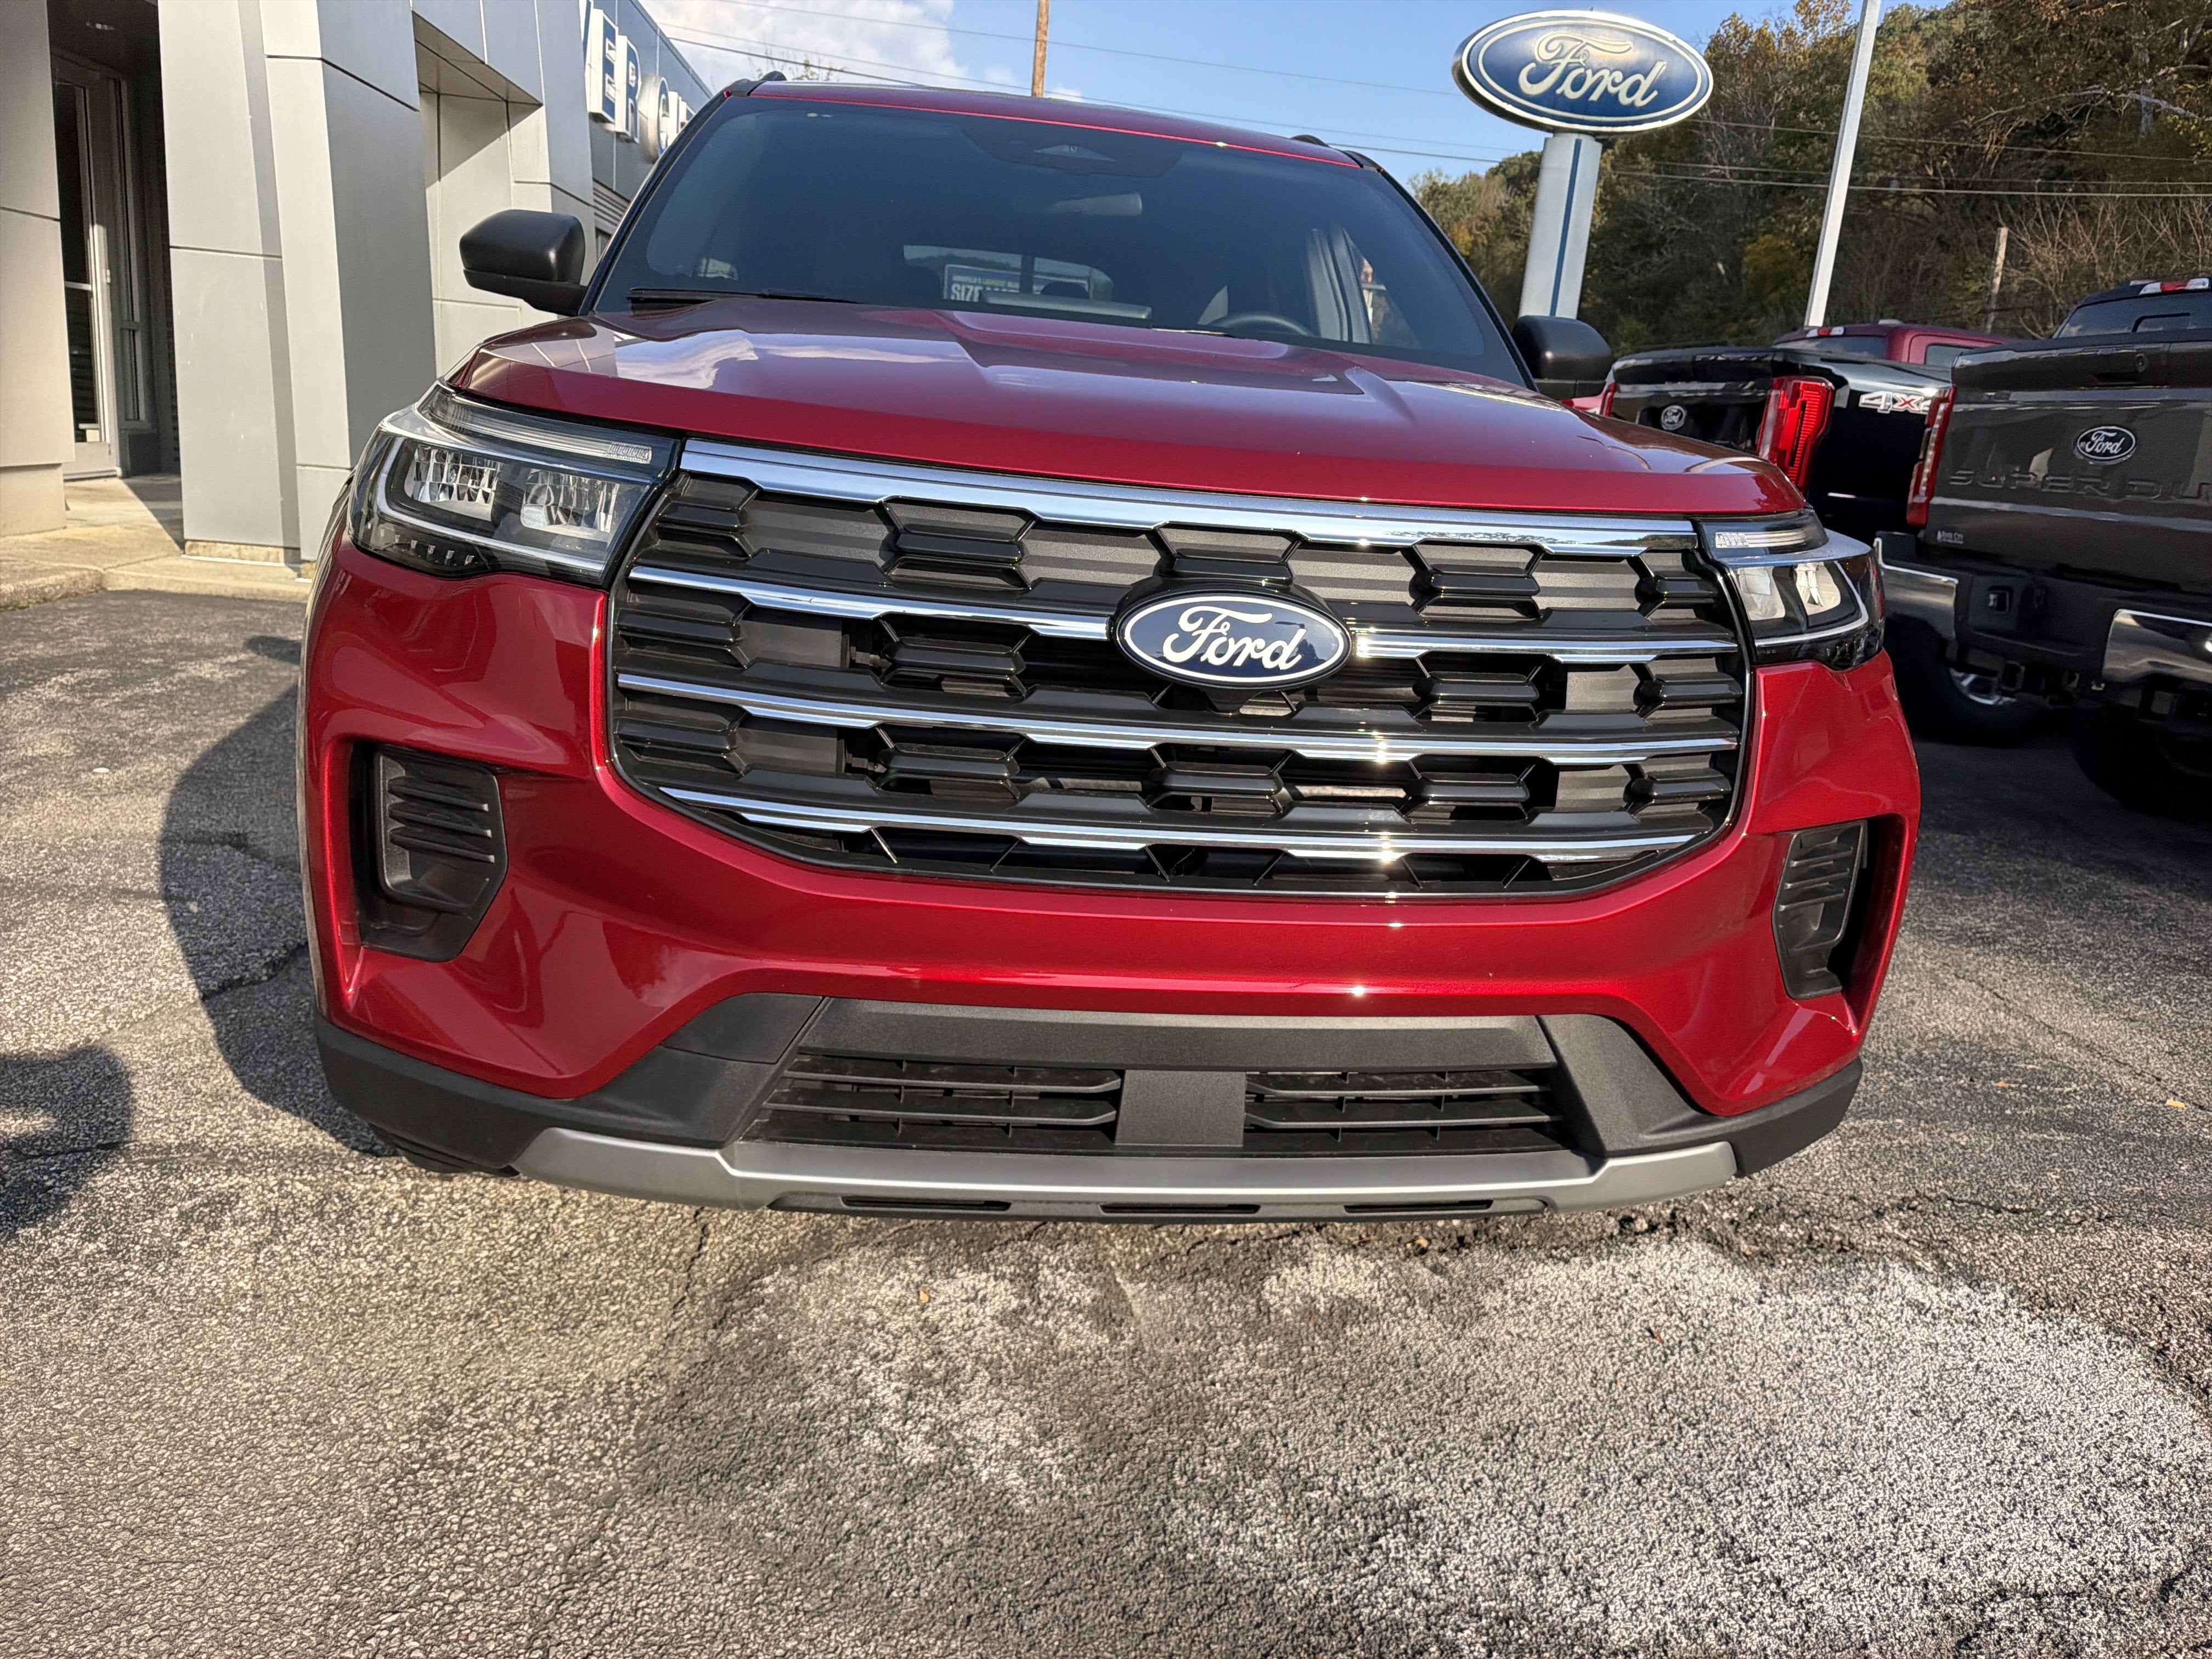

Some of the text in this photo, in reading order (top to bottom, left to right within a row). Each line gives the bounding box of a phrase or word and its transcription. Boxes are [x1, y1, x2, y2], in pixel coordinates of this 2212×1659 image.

[1518, 32, 1667, 108] Ford
[2085, 430, 2125, 454] Ford
[1948, 469, 2110, 496] SUPER
[1162, 606, 1307, 670] Ford
